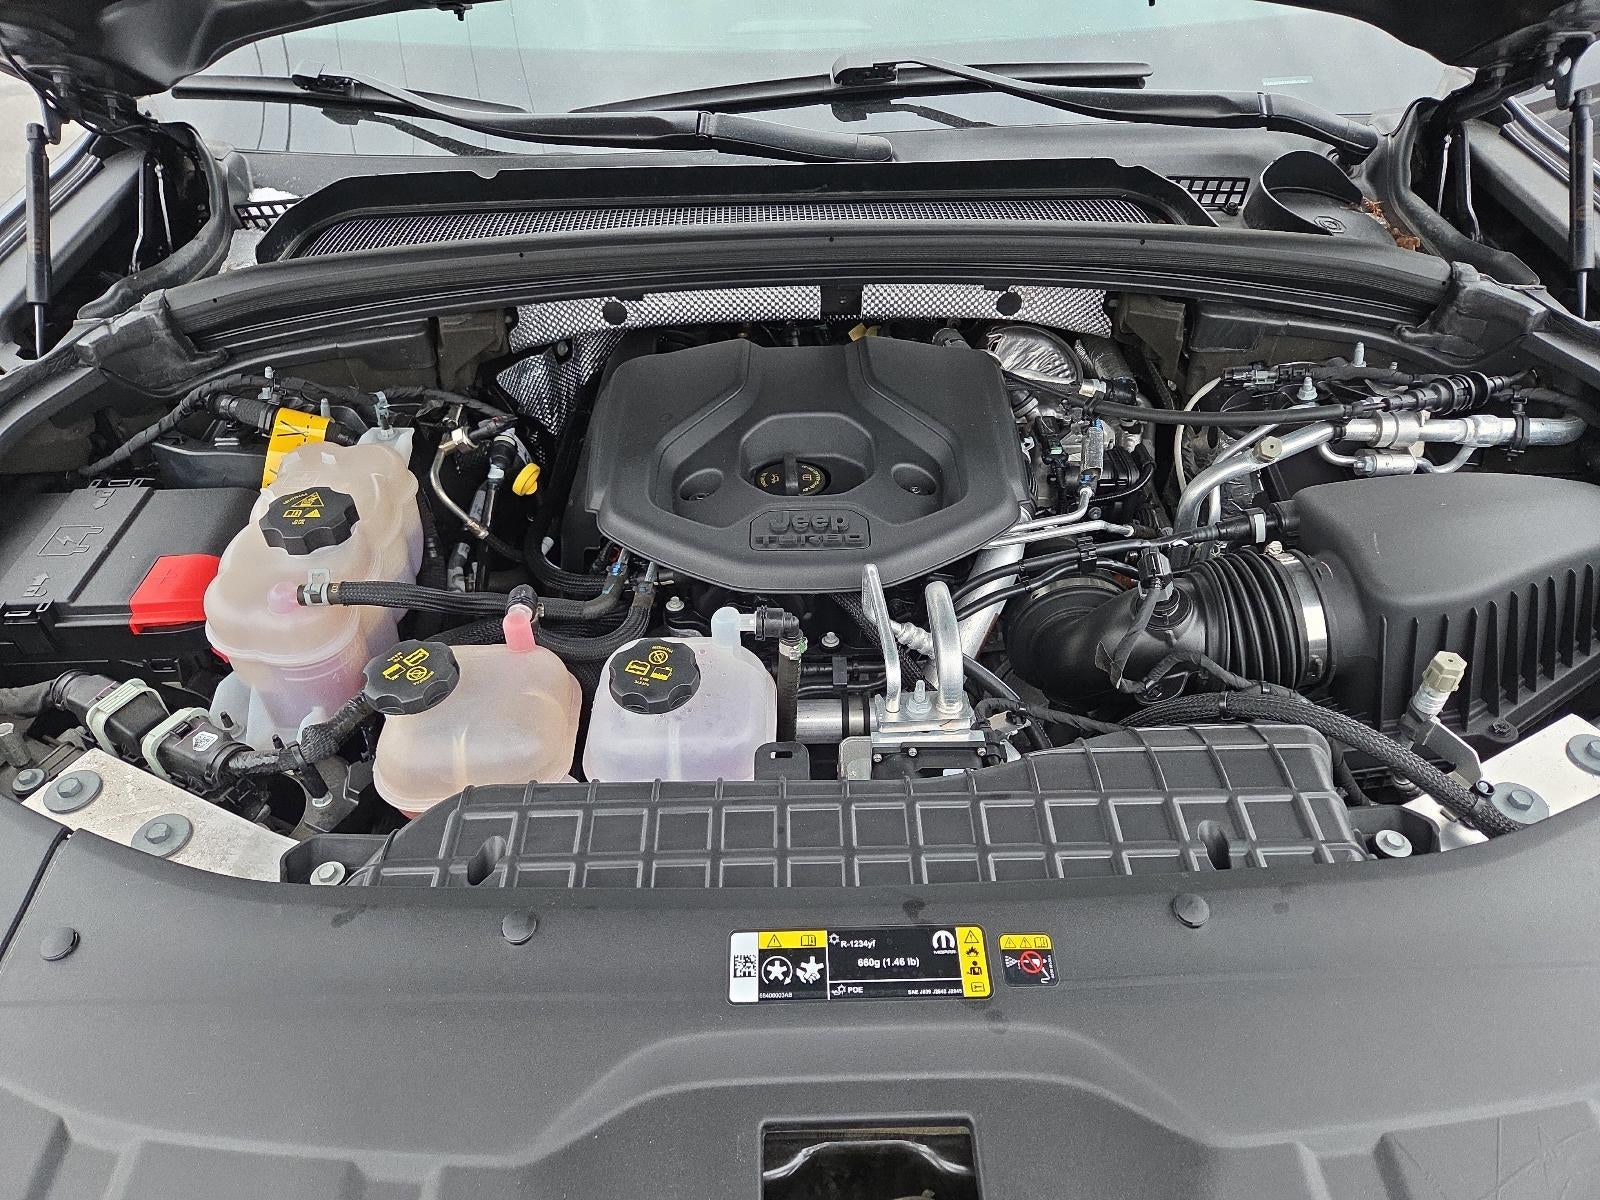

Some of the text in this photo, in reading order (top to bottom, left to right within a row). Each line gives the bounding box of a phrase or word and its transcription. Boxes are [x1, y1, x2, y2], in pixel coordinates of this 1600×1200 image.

[769, 511, 849, 534] Jeep
[840, 939, 876, 949] R-1234yf
[857, 958, 880, 968] 660g
[907, 957, 920, 968] lb)
[847, 986, 864, 994] POE
